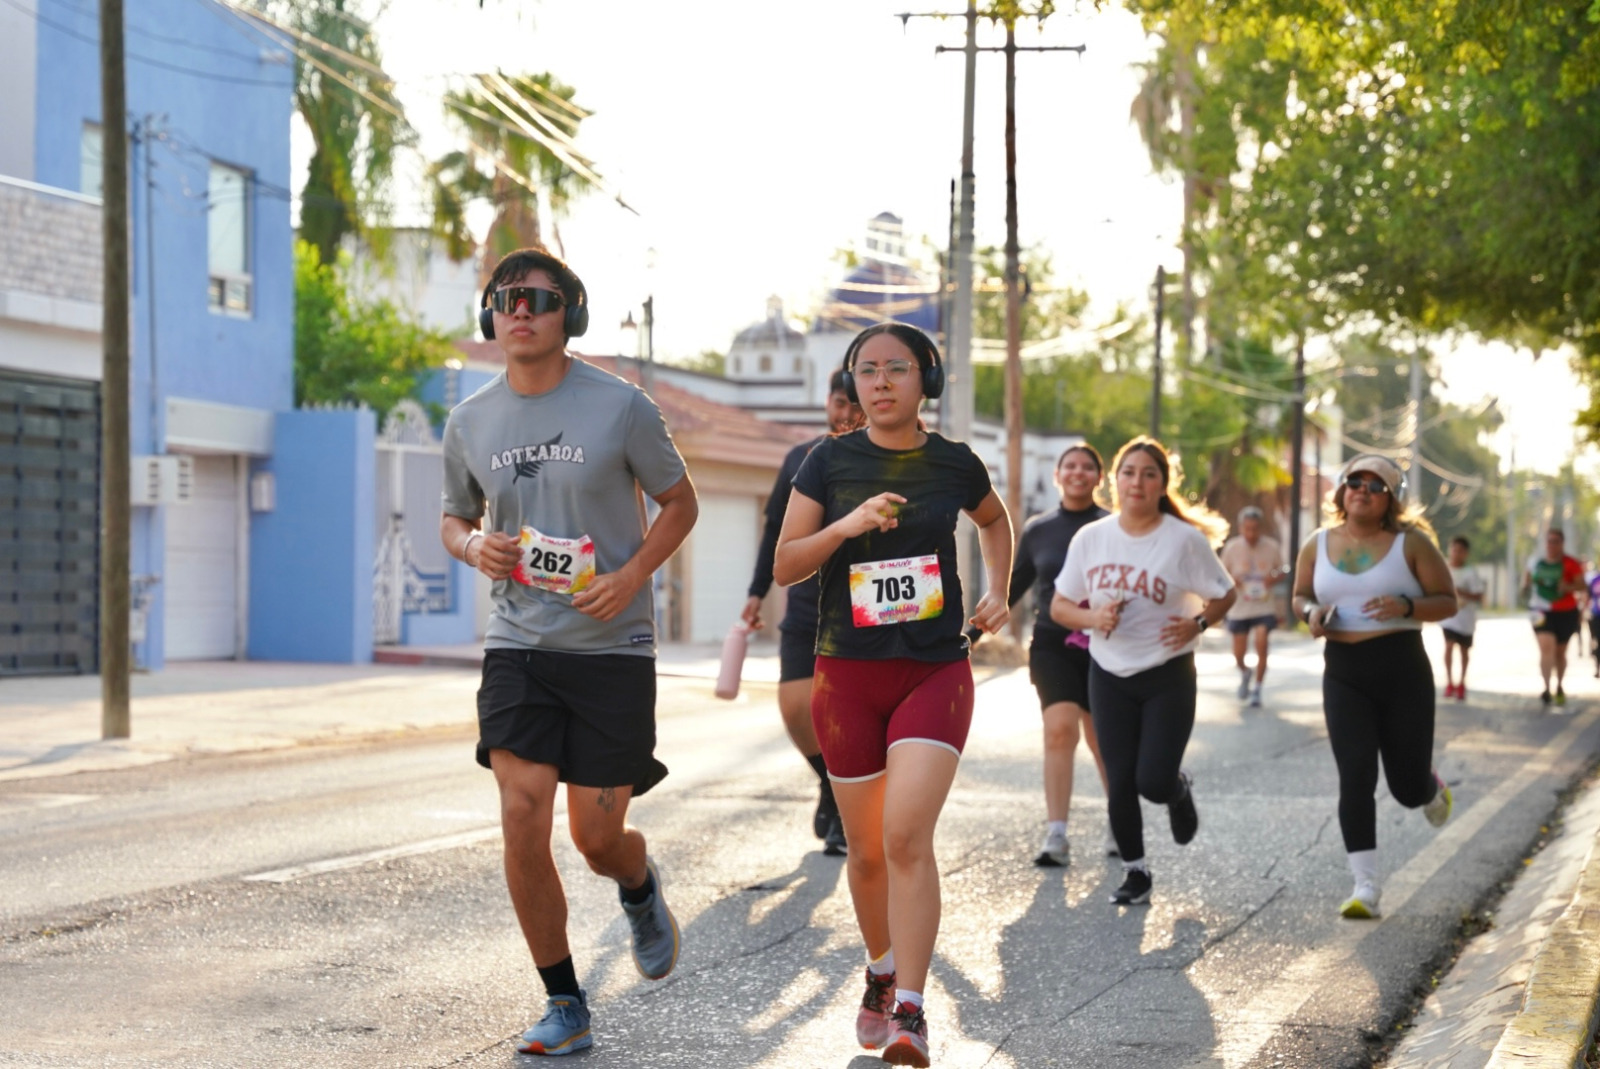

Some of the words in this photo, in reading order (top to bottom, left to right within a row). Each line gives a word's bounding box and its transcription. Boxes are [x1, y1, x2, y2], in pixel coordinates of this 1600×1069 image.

[490, 444, 585, 471] AOTEAROA
[530, 547, 572, 575] 262
[872, 575, 916, 603] 703
[1087, 564, 1167, 605] TEXAS
